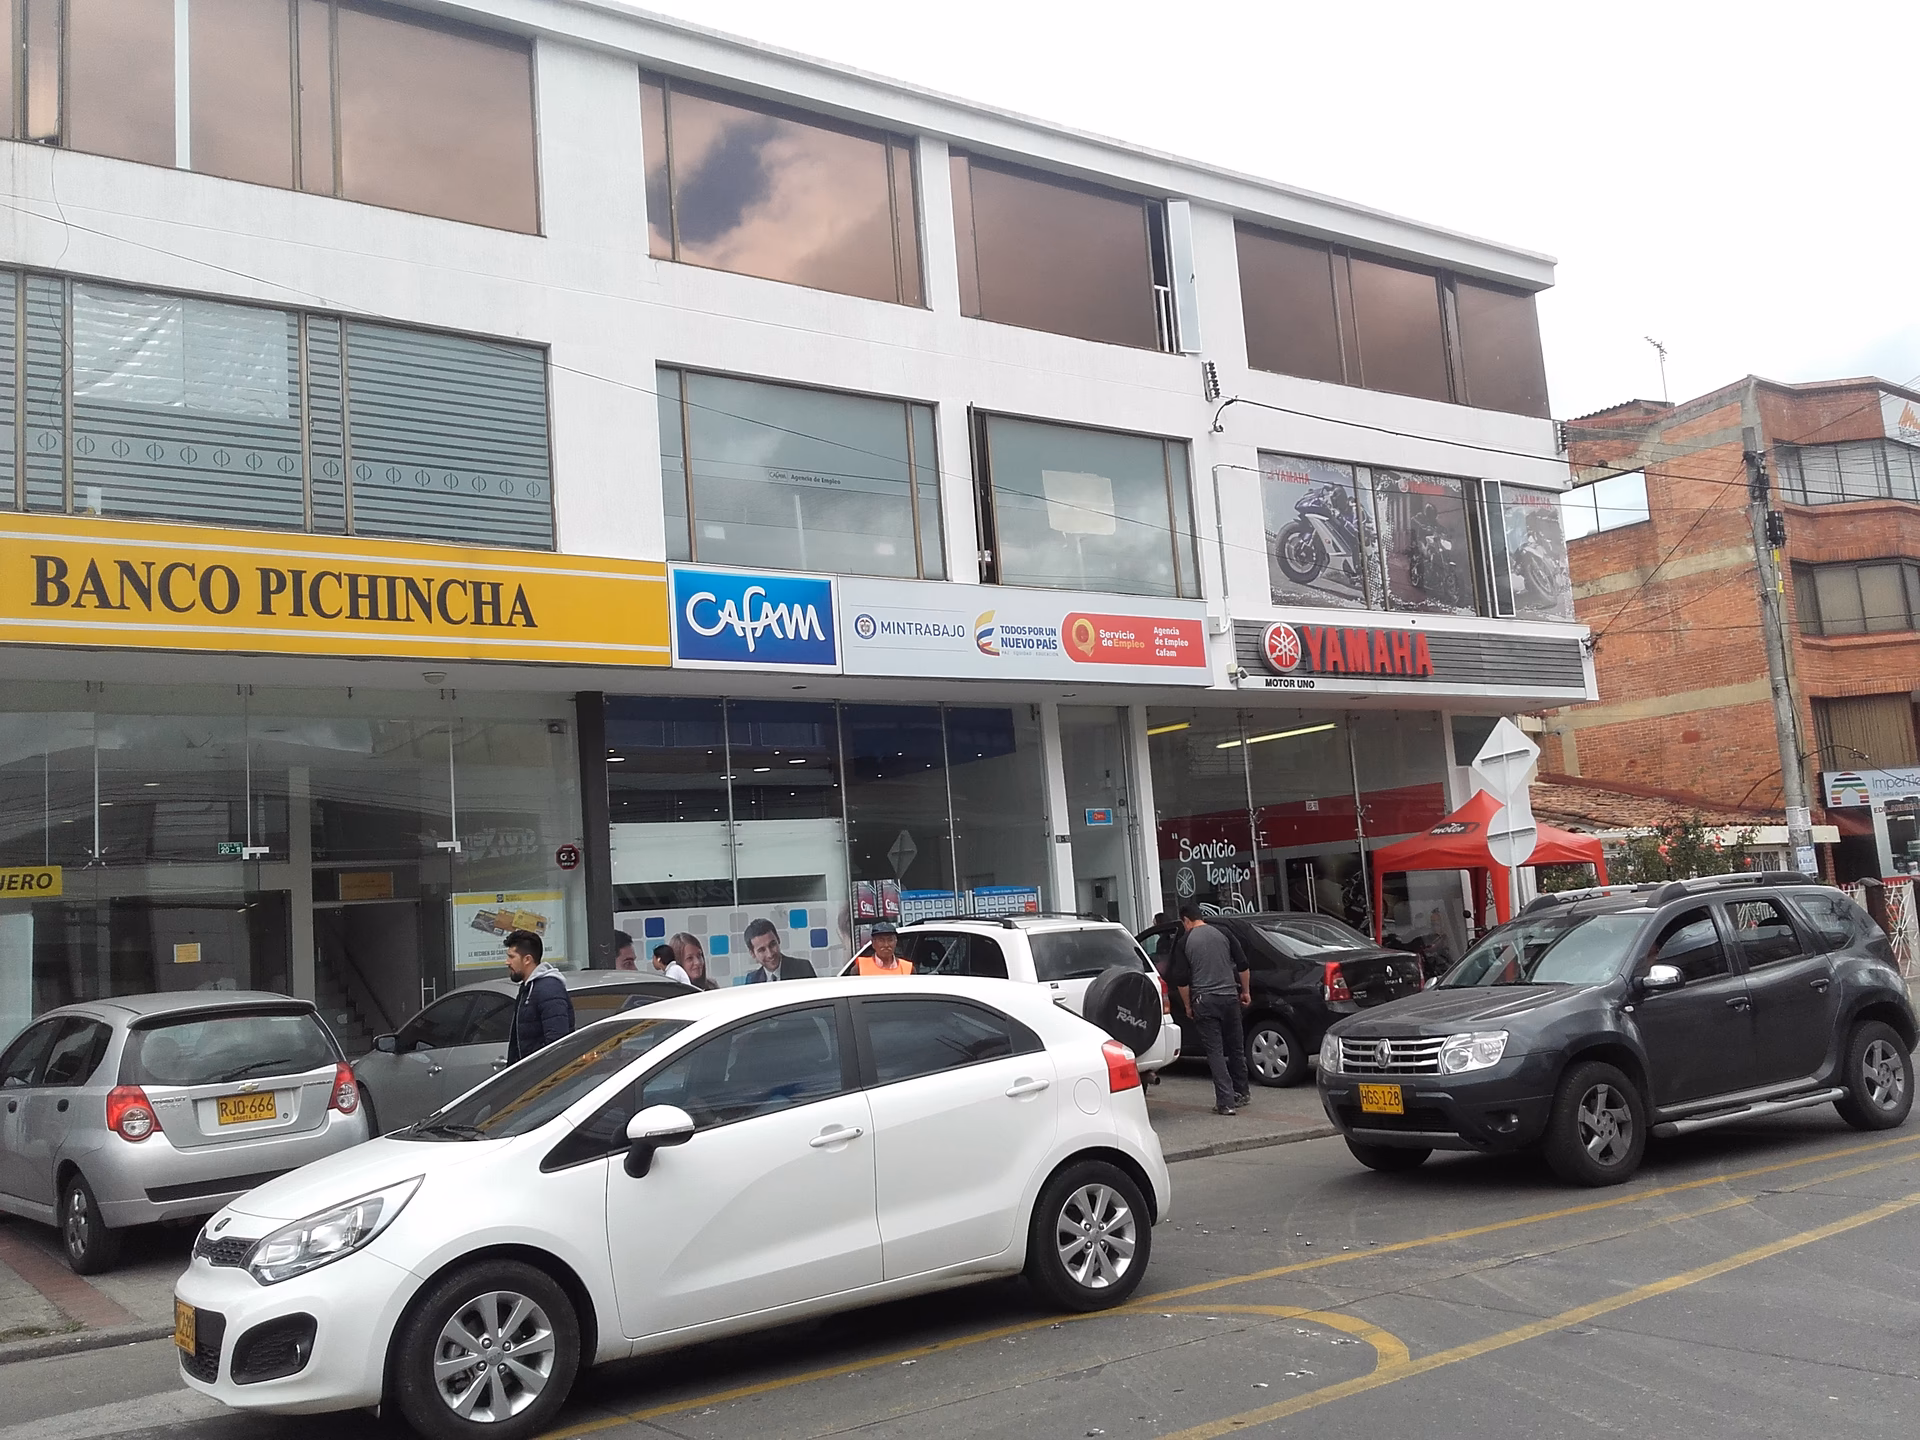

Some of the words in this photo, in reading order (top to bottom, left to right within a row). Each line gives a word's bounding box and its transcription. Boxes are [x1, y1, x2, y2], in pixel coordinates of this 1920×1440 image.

[791, 474, 813, 483] Agencia
[821, 477, 841, 485] Empleo
[1276, 469, 1310, 485] YAMAHA
[31, 554, 240, 615] BANCO
[256, 567, 538, 629] PICHINCHA
[881, 620, 965, 638] MINTRABAJO
[1000, 625, 1027, 635] TODOS
[1028, 626, 1045, 636] POR
[1045, 627, 1057, 636] UN
[1099, 629, 1135, 640] Servicio
[1153, 626, 1179, 637] Agencia
[1000, 637, 1035, 649] NUEVO
[1036, 638, 1058, 650] PAÍS
[1102, 638, 1113, 647] de
[1113, 639, 1145, 650] Empleo
[1155, 637, 1163, 646] de
[1164, 638, 1189, 648] Empleo
[1155, 648, 1177, 657] Cafam
[1302, 625, 1434, 677] YAMAHA
[1265, 678, 1295, 688] MOTOR
[1296, 679, 1315, 689] UNO
[1116, 1011, 1148, 1029] RAV4
